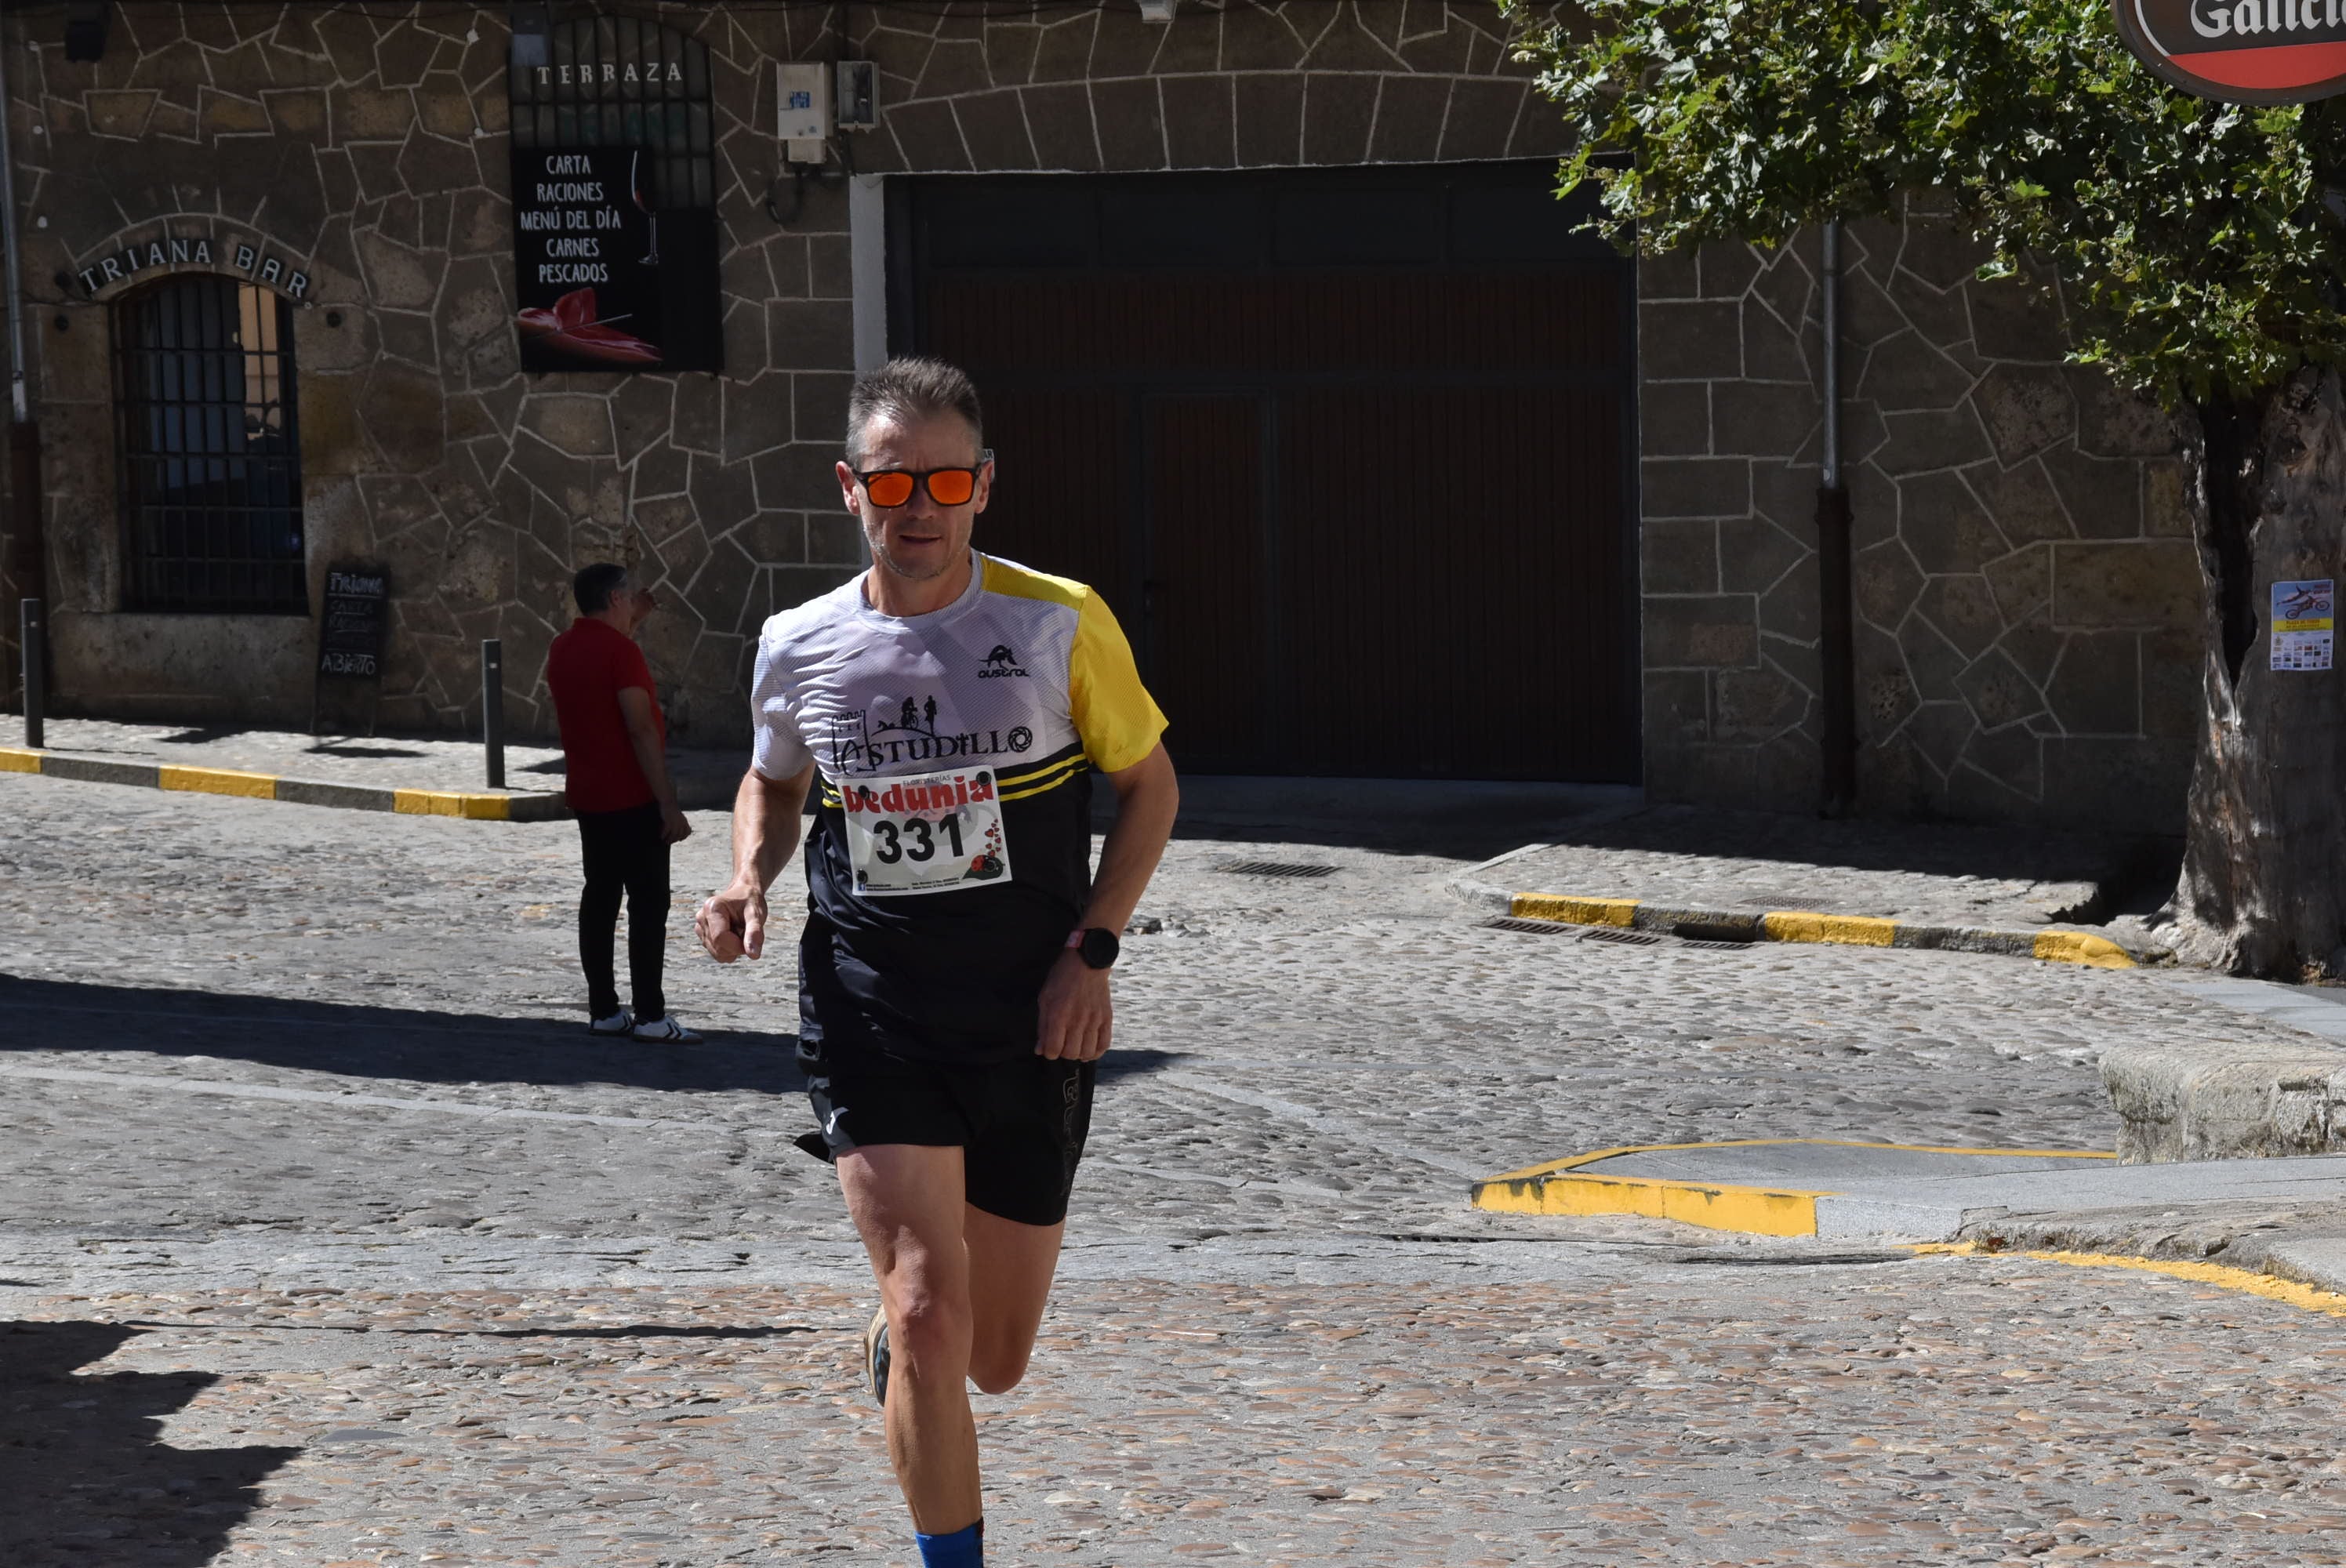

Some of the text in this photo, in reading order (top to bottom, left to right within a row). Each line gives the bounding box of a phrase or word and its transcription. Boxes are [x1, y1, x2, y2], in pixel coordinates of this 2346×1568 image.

[2190, 0, 2346, 38] Galici
[537, 63, 682, 84] TERRAZA
[545, 154, 592, 175] CARTA
[536, 182, 604, 201] RACIONES
[520, 205, 621, 230] MENÚ DEL DÍA
[546, 237, 600, 257] CARNES
[78, 240, 307, 298] TRIANA BAR
[539, 263, 609, 283] PESCADOS
[841, 775, 994, 814] bedunia
[873, 813, 964, 865] 331
